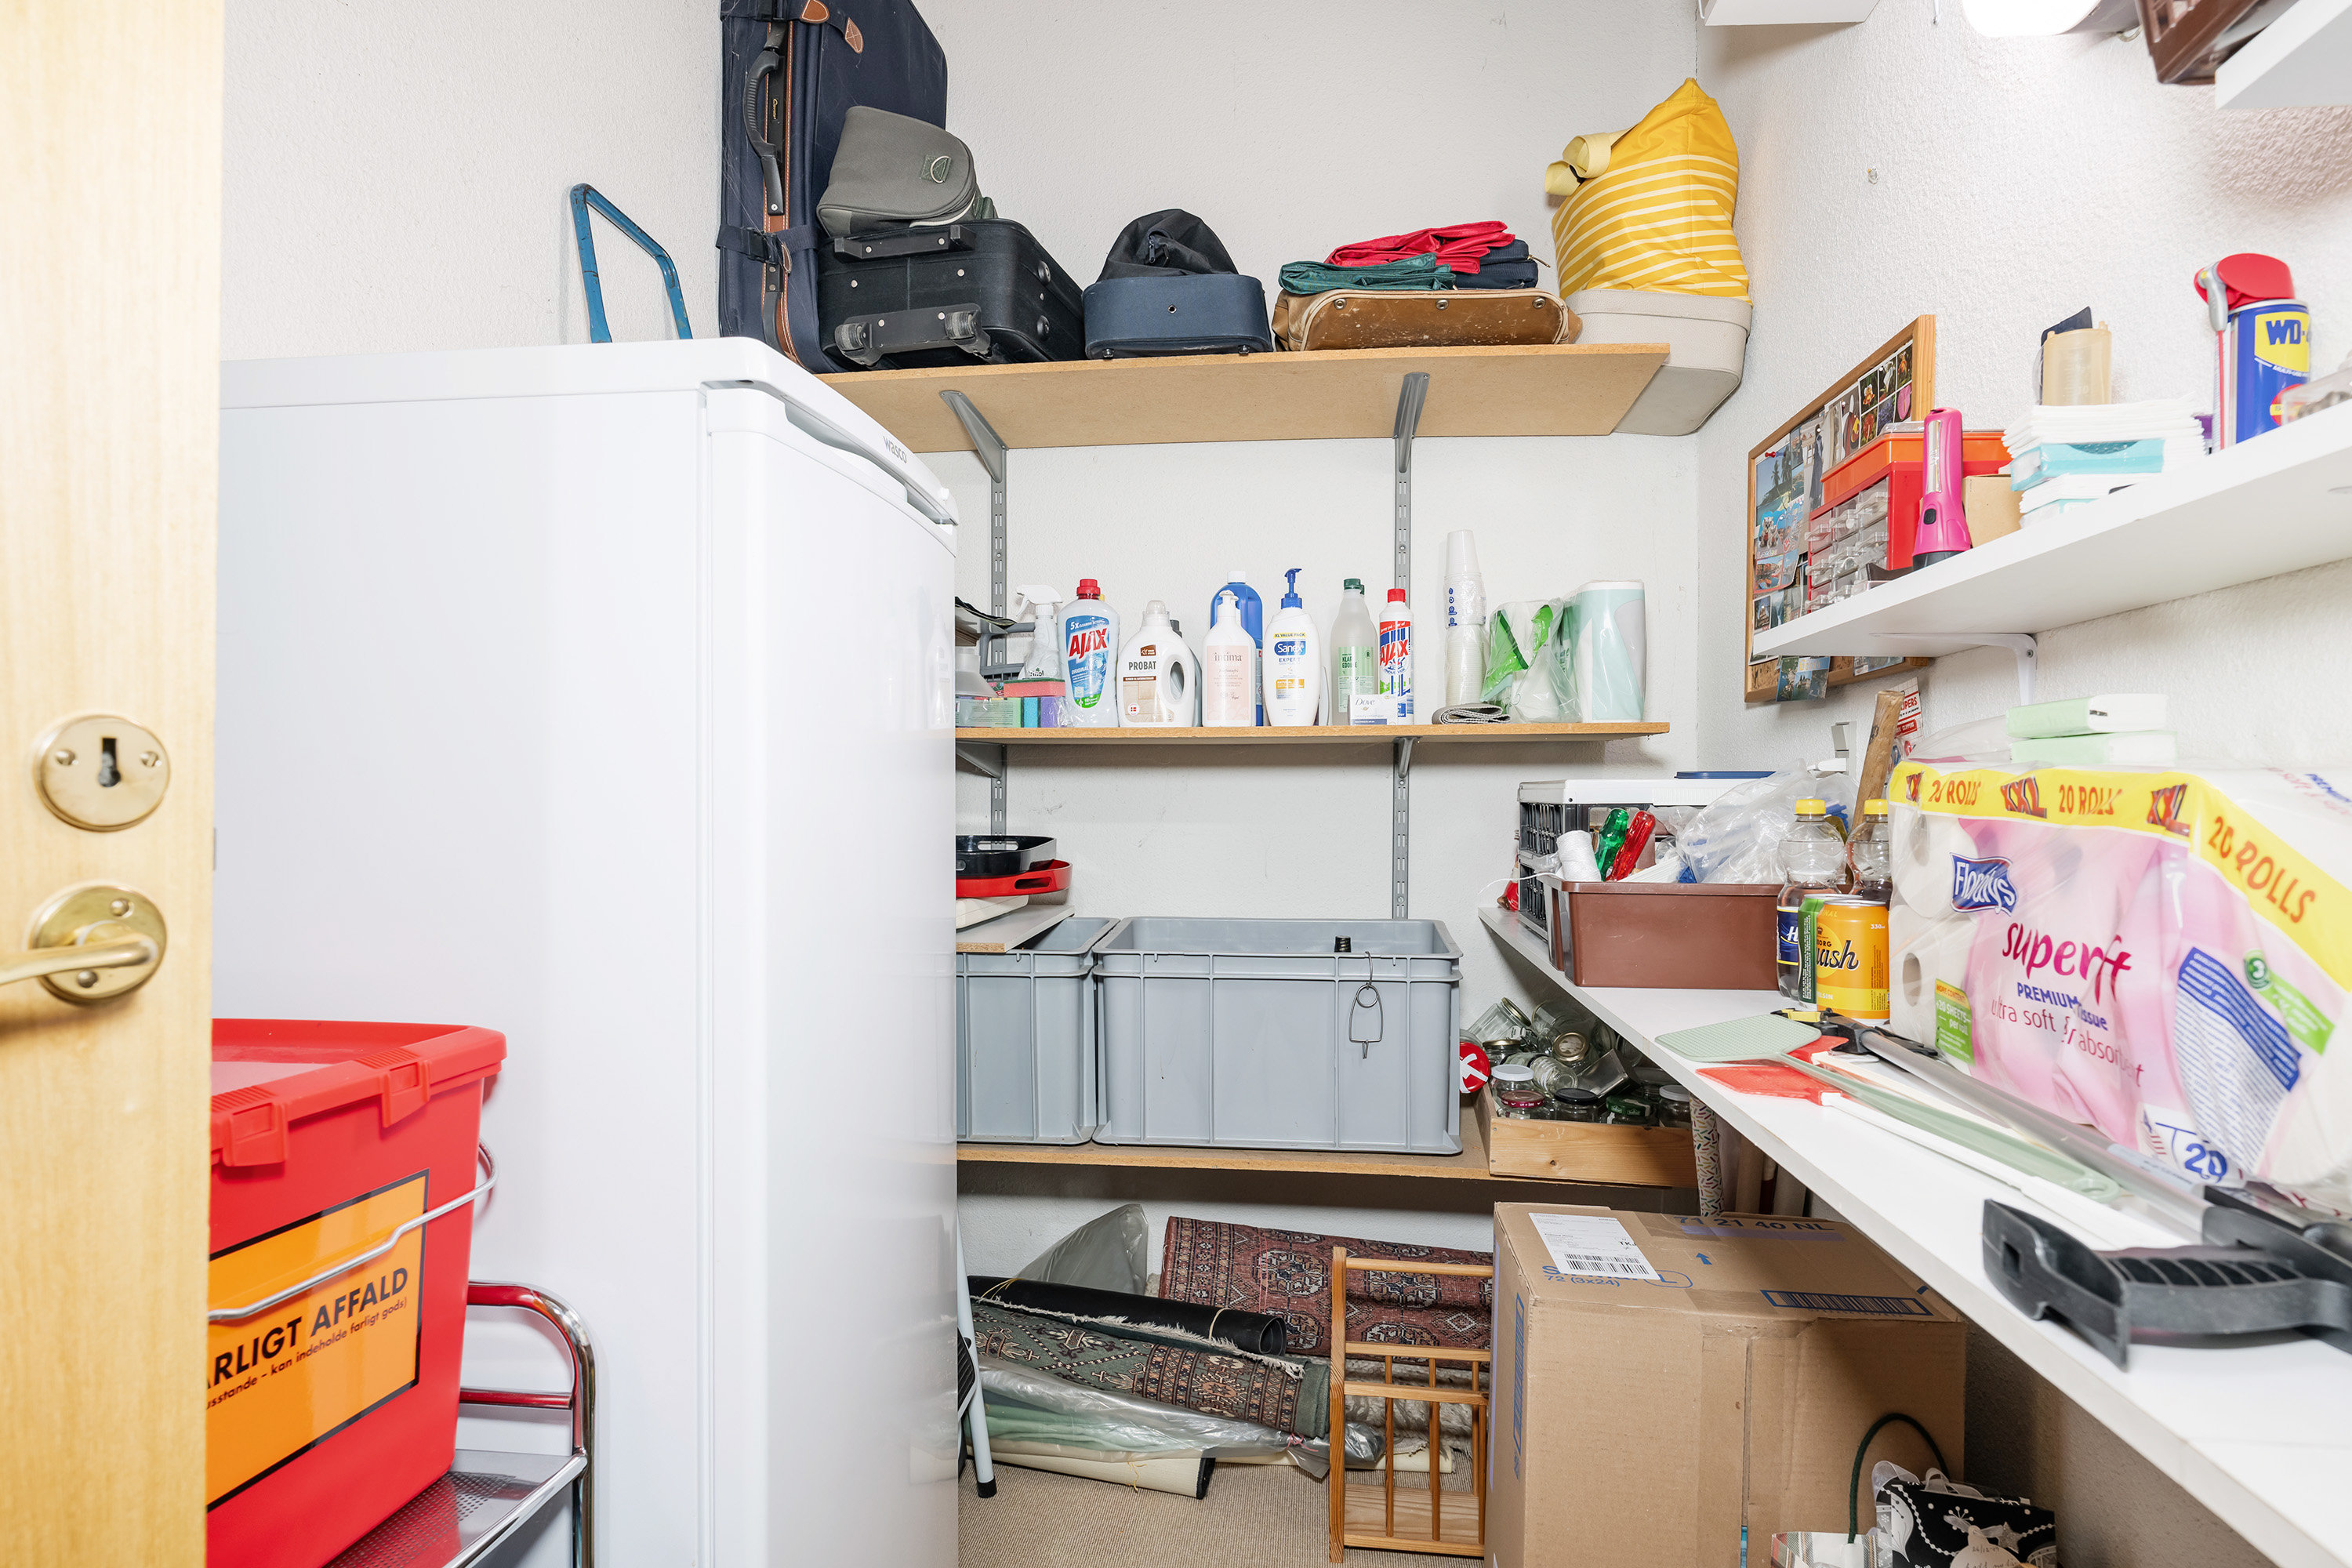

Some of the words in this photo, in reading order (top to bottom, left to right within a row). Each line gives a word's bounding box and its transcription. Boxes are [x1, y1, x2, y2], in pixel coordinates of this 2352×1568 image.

[883, 435, 907, 463] wasco
[1069, 628, 1107, 659] AJAX
[1277, 643, 1303, 653] Sanex
[1380, 639, 1408, 666] AJAX
[1128, 661, 1156, 670] PROBAT
[1214, 652, 1243, 662] intima
[2000, 776, 2047, 819] XXL
[2059, 785, 2074, 814] 20
[2147, 783, 2190, 837] XXL
[2209, 816, 2234, 858] 20
[2236, 840, 2315, 923] ROLLS
[2024, 1009, 2056, 1032] soft
[1713, 1218, 1744, 1227] 21
[1755, 1221, 1786, 1229] 40
[1792, 1222, 1835, 1231] NL
[1570, 1277, 1621, 1287] (3x24)
[207, 1316, 303, 1390] RLIGT
[310, 1267, 408, 1338] AFFALD
[271, 1357, 293, 1376] kan
[296, 1328, 347, 1363] indeholde
[350, 1310, 380, 1335] farligt
[382, 1296, 408, 1321] gods)
